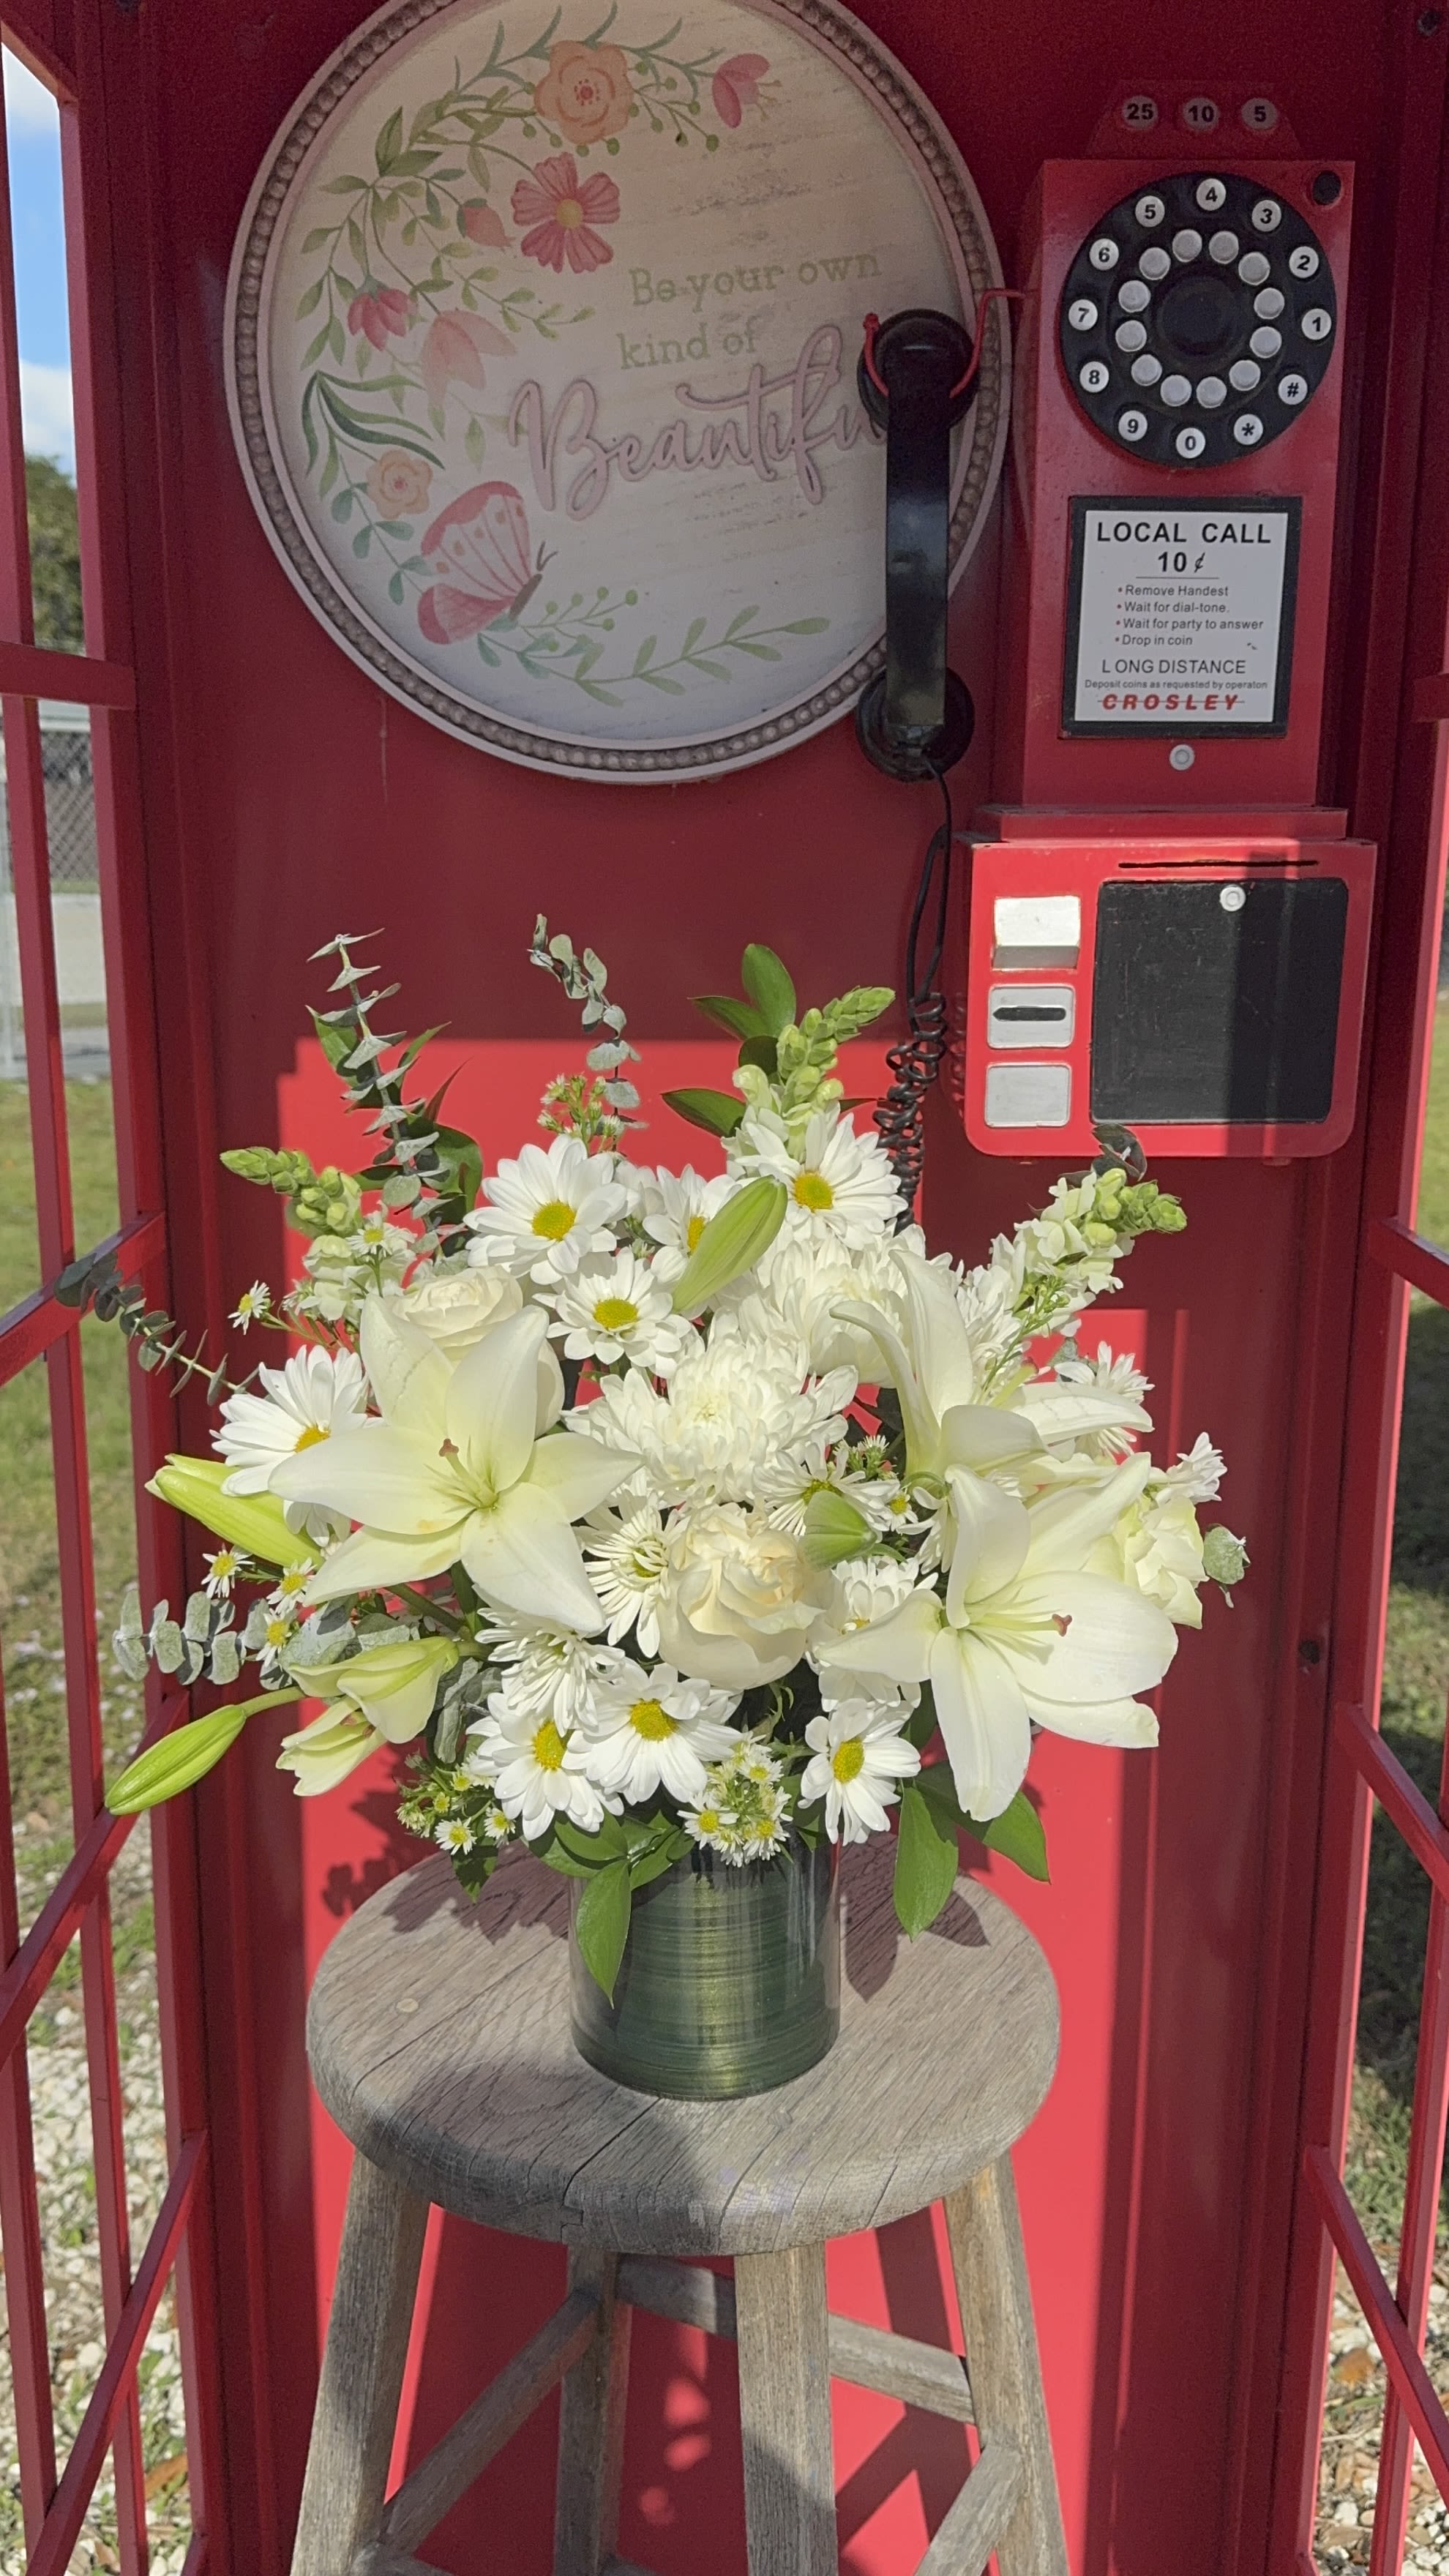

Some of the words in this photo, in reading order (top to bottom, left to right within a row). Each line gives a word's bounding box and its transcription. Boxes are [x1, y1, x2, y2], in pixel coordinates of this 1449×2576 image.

[1126, 102, 1154, 121] 25
[1187, 105, 1215, 123] 10
[1254, 105, 1268, 122] 5
[1205, 187, 1218, 203] 4
[1144, 203, 1156, 220] 5
[1259, 208, 1273, 225] 3
[1098, 247, 1110, 263] 6
[1296, 255, 1311, 272] 2
[629, 267, 678, 306] Be
[685, 265, 785, 313] your
[798, 252, 882, 285] own
[1078, 307, 1090, 323] 7
[1312, 316, 1321, 332] 1
[616, 322, 710, 370] kind
[721, 316, 759, 356] of
[1088, 370, 1100, 385] 8
[511, 323, 887, 520] Beautifu
[1127, 419, 1139, 434] 9
[1184, 435, 1197, 452] 0
[1097, 522, 1187, 543] LOCAL
[1202, 523, 1271, 544] CALL
[1124, 585, 1175, 597] Remove
[1177, 585, 1229, 597] Handest
[1123, 602, 1151, 613] Wait
[1153, 602, 1171, 613] for
[1122, 618, 1150, 629] Wait
[1152, 618, 1169, 629] for
[1171, 619, 1202, 632] party
[1205, 618, 1217, 630] to
[1218, 621, 1264, 631] answer
[1121, 634, 1152, 647] Drop
[1153, 634, 1165, 645] in
[1167, 634, 1194, 645] coin
[1101, 659, 1155, 675] LONG
[1158, 659, 1246, 675] DISTANCE
[1084, 679, 1122, 690] Deposit
[1123, 680, 1148, 689] coins
[1150, 681, 1161, 689] as
[1162, 680, 1210, 691] requested
[1212, 679, 1224, 691] by
[1102, 693, 1239, 711] CROSLEY
